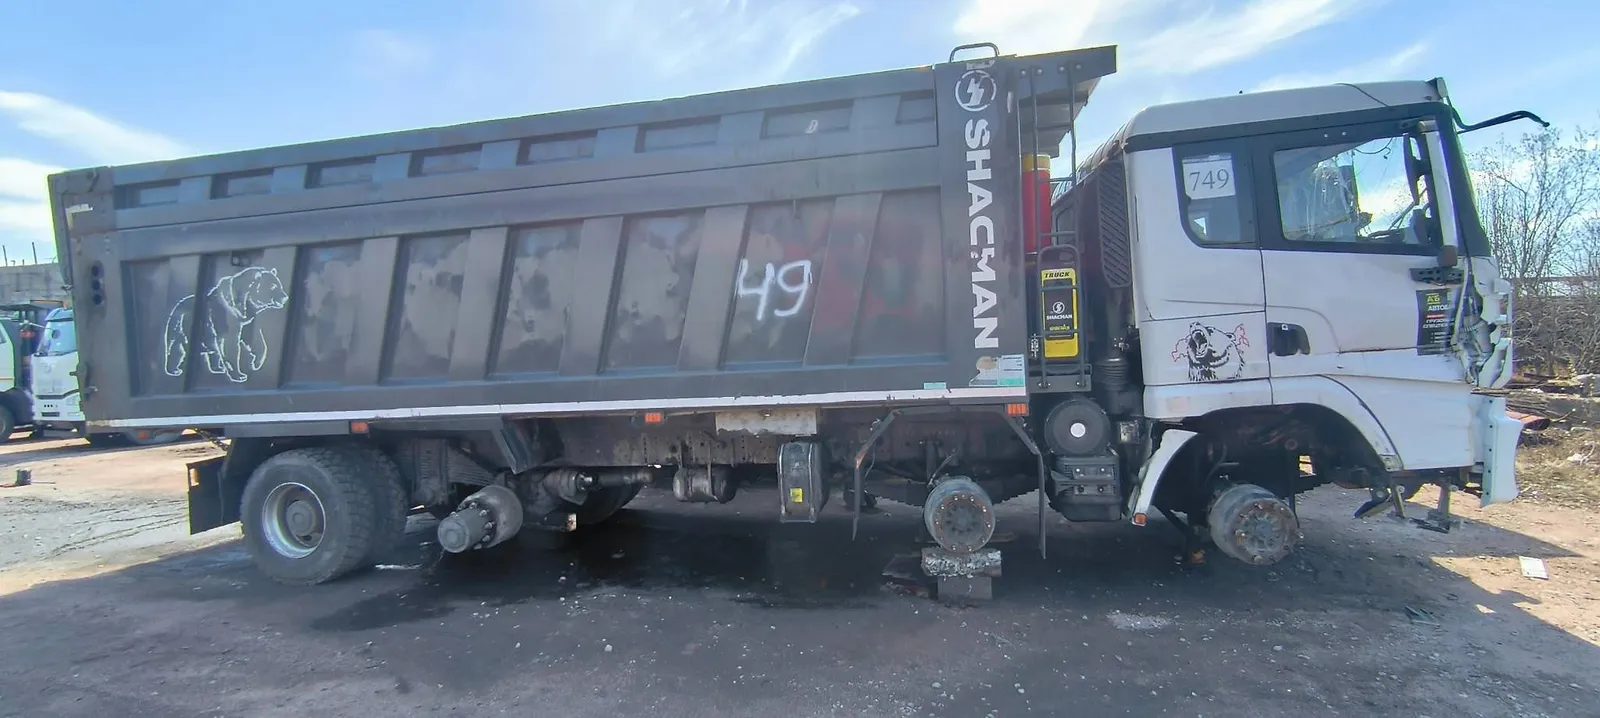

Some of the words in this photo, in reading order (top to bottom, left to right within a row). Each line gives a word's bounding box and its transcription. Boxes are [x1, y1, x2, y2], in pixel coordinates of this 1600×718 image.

[1190, 168, 1230, 192] 749
[964, 118, 999, 349] SHACMAN
[735, 258, 813, 321] 49
